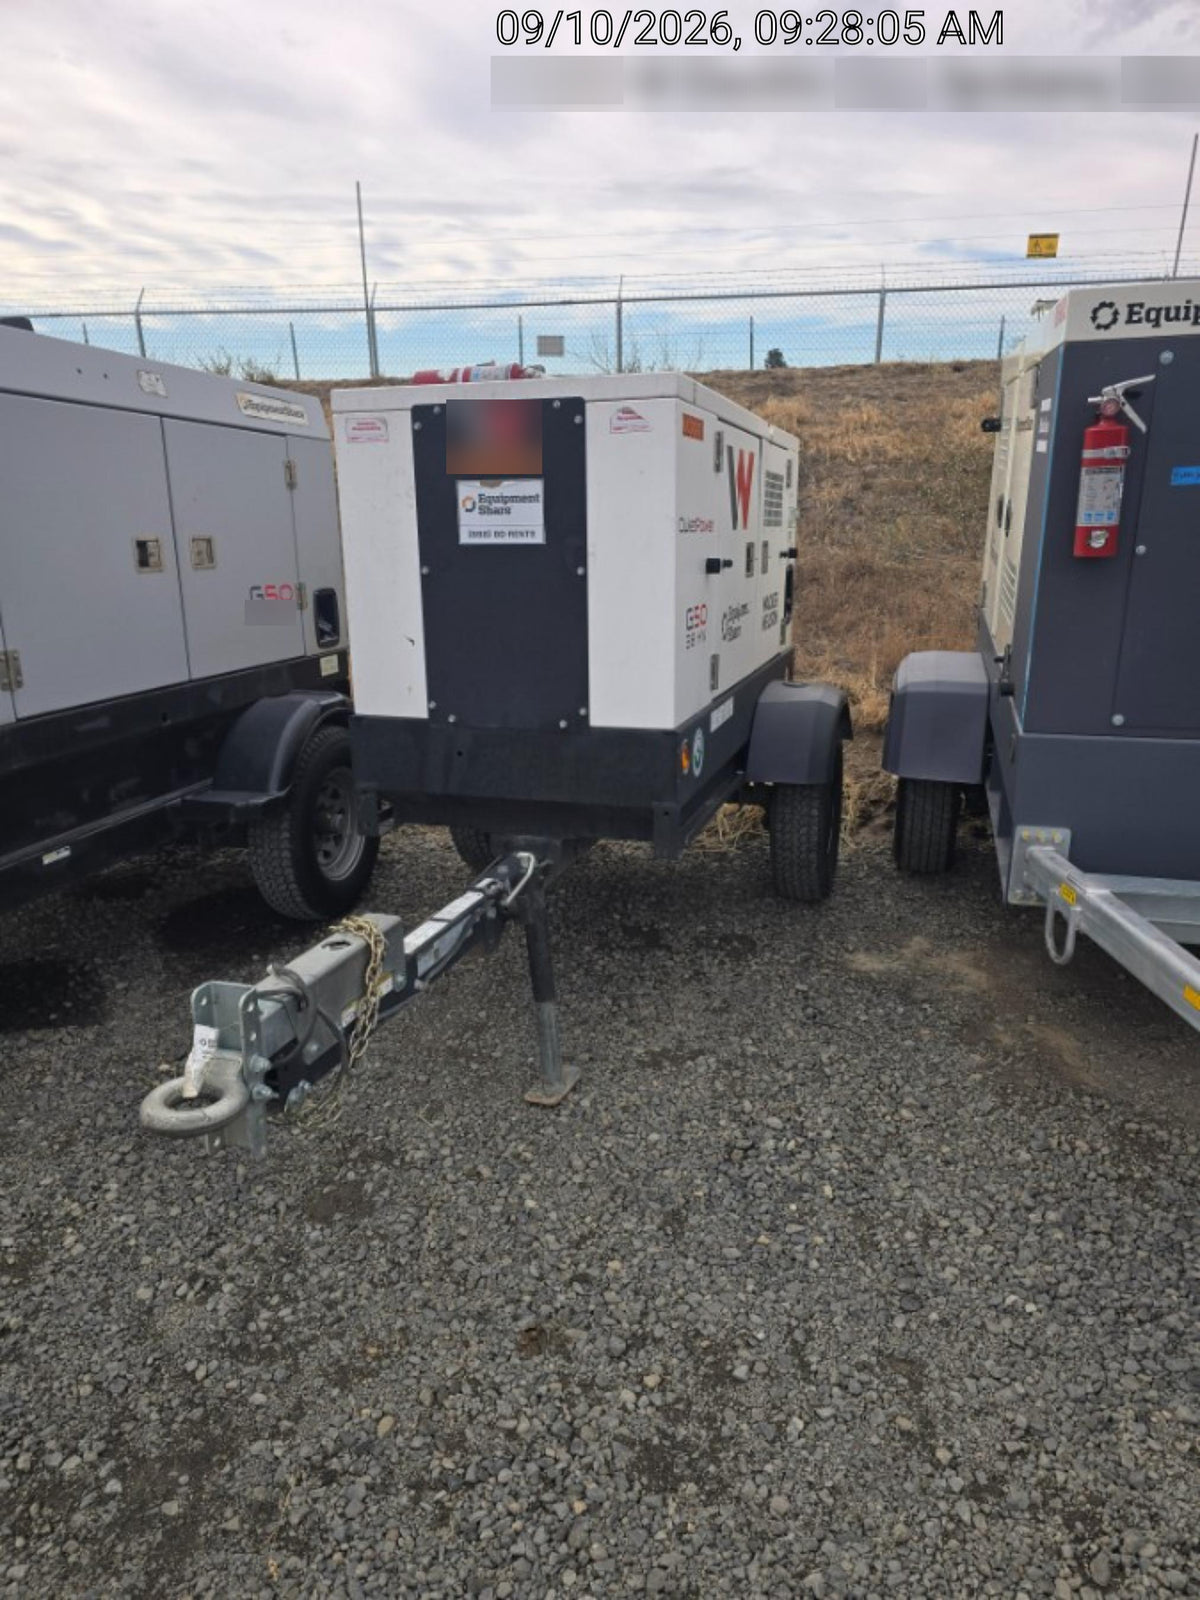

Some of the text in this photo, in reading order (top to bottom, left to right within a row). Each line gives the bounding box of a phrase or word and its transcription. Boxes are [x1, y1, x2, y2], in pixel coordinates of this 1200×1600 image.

[478, 492, 540, 506] Equipment
[478, 505, 512, 515] Share
[686, 603, 708, 631] G50
